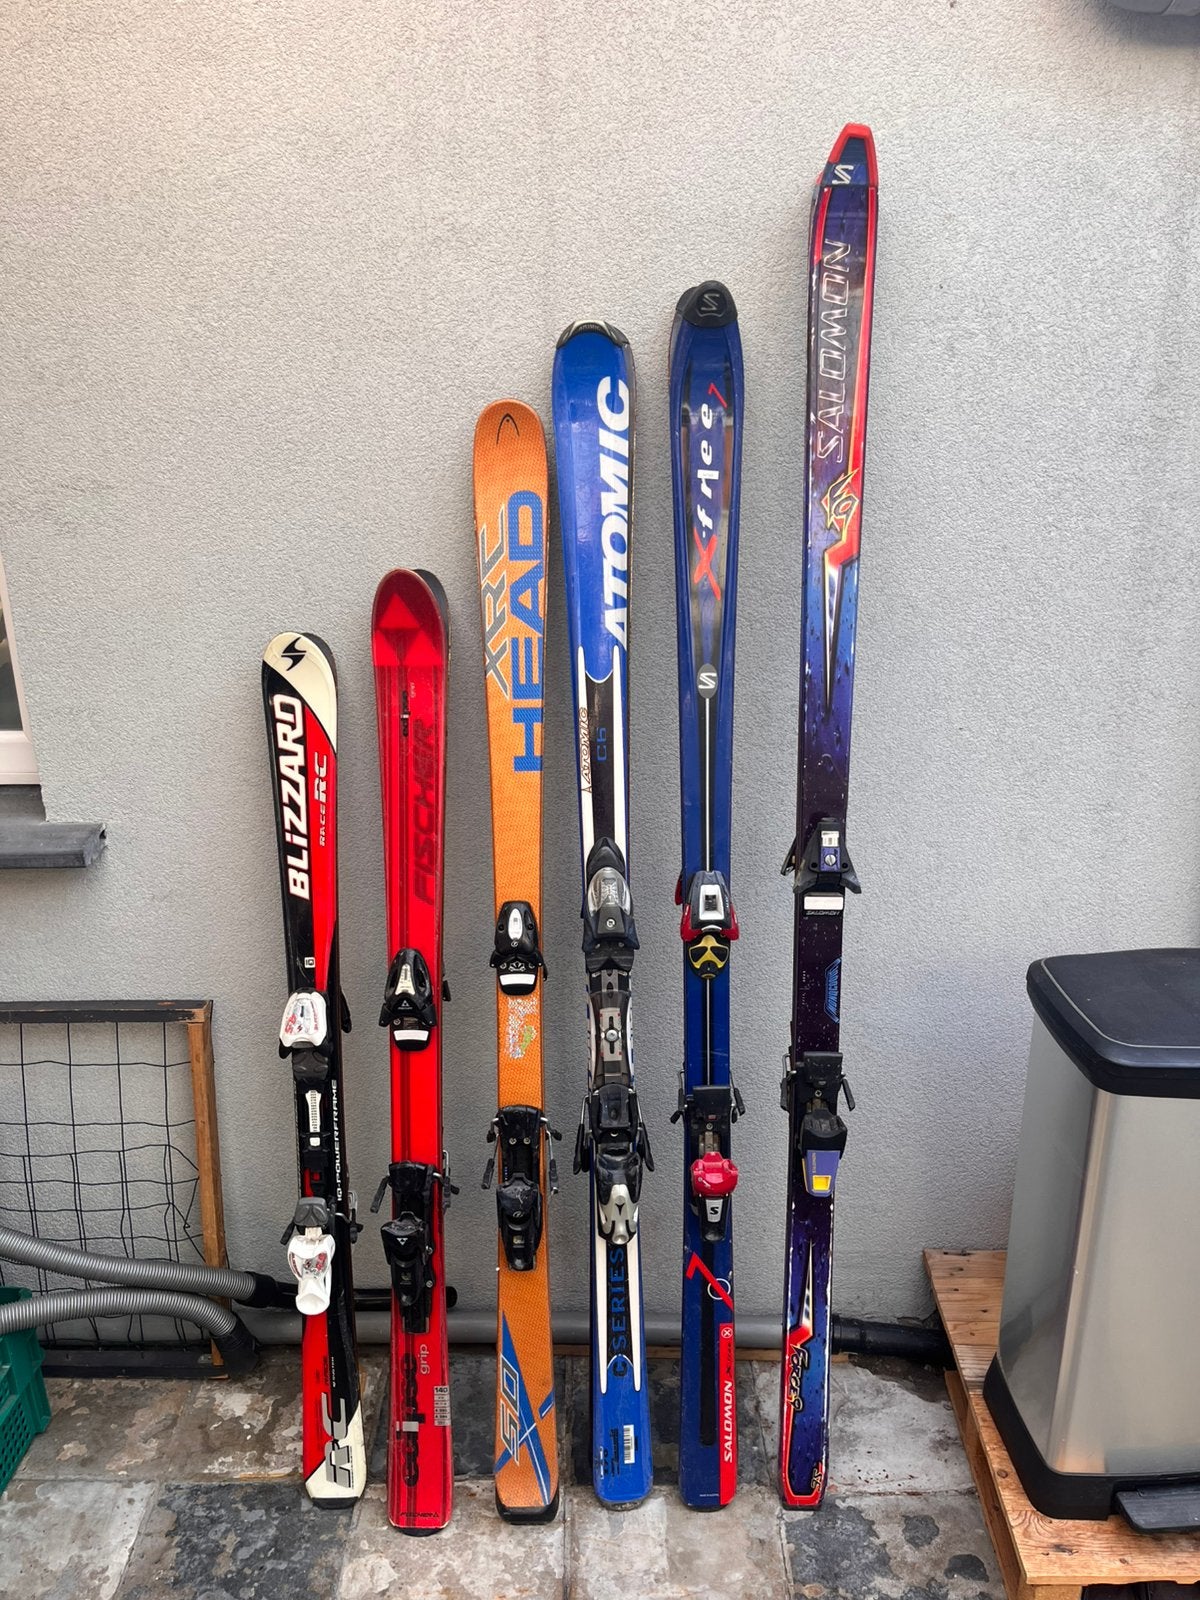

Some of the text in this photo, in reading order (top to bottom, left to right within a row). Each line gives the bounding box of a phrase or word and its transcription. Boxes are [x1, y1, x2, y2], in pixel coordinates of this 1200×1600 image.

[815, 238, 851, 463] SALOMON
[597, 376, 630, 651] ATOMIC
[479, 503, 510, 700] XRC
[507, 490, 544, 772] HEAD
[413, 718, 435, 906] FISCHER
[578, 707, 592, 786] ATOMIC
[331, 1079, 343, 1201] IQ-POWERFRAME
[419, 1344, 430, 1374] grip
[610, 1247, 627, 1351] SERIES
[724, 1381, 733, 1463] SALOMON
